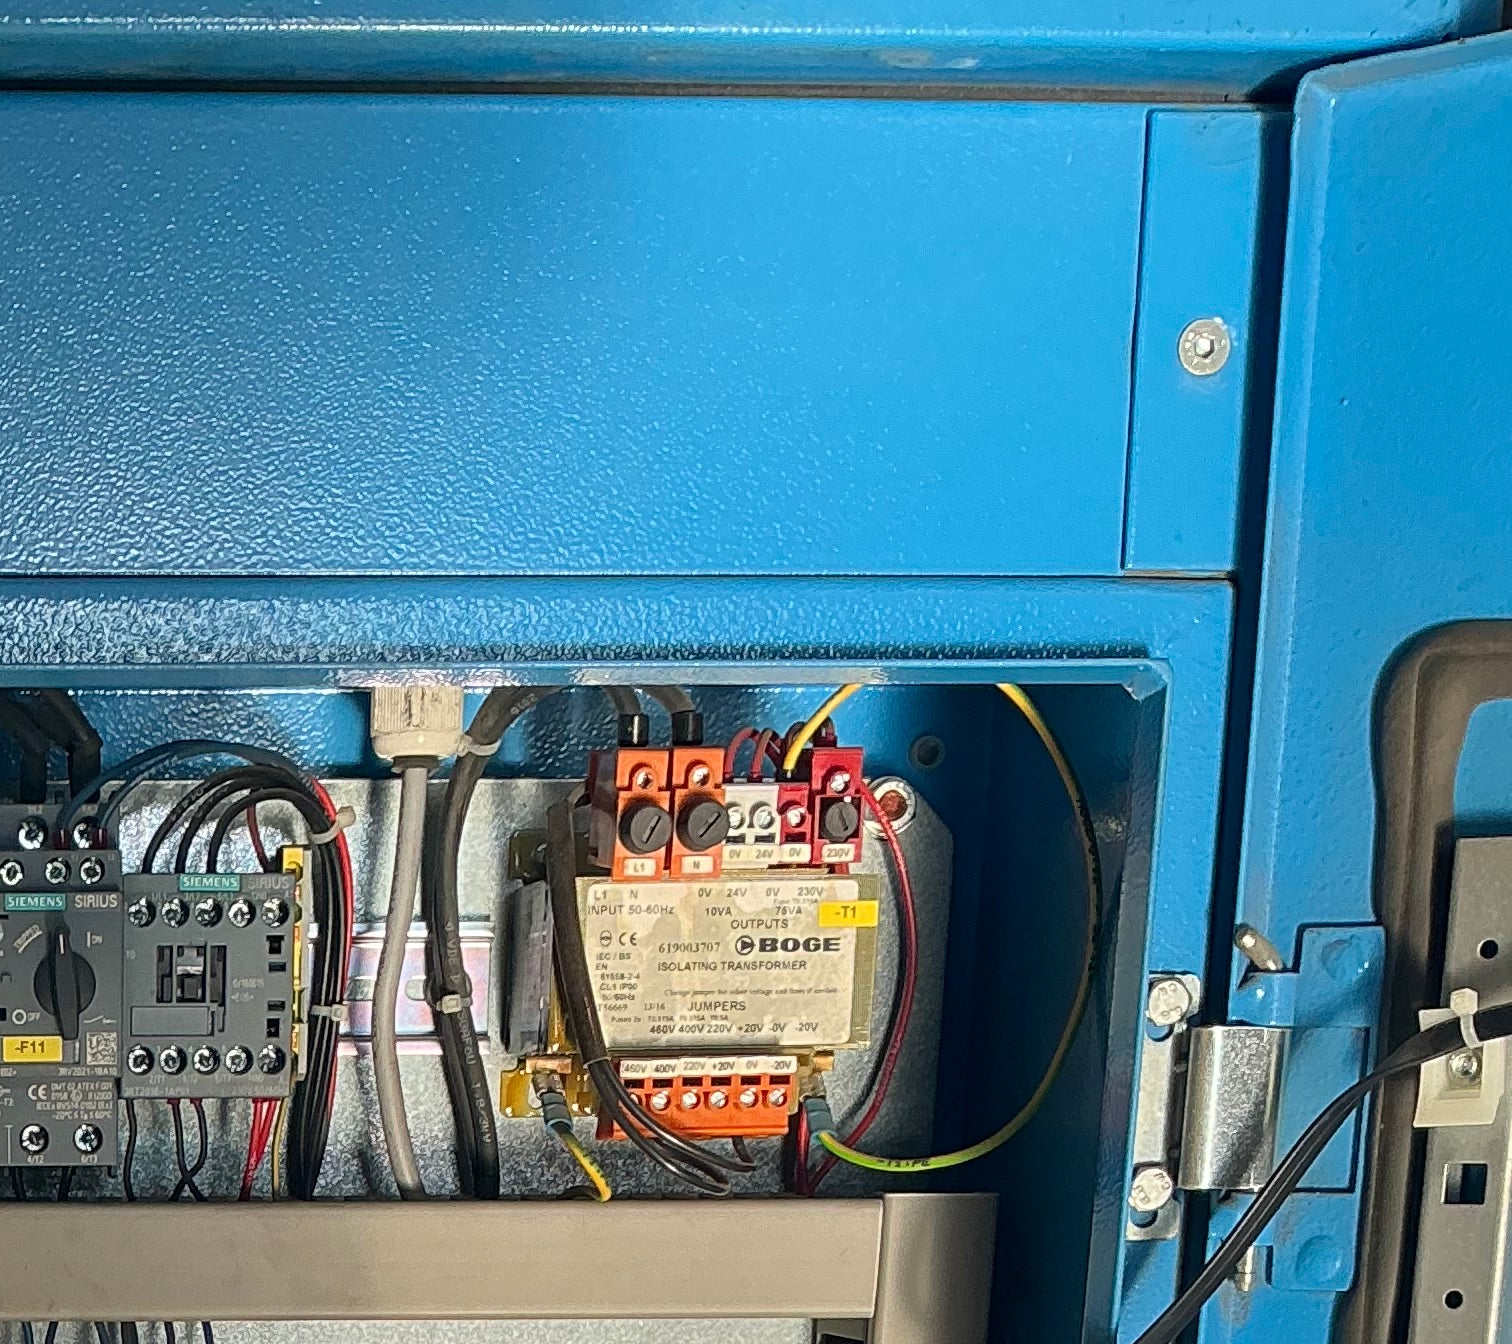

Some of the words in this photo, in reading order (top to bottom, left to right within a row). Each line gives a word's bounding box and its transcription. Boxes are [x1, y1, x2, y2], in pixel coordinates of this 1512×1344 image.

[634, 863, 644, 872] L1
[183, 877, 239, 887] SIEMENS
[248, 877, 289, 889] SIRIUS
[594, 890, 607, 900] L1
[630, 890, 638, 899] N
[698, 889, 711, 897] 0V
[727, 888, 747, 897] 24V
[766, 888, 779, 897] 0V
[798, 887, 824, 896] 230V
[7, 898, 63, 907] SIEMENS
[75, 895, 117, 908] SIRIUS
[588, 905, 624, 915] INPUT
[628, 905, 675, 915] 50-60Hz
[705, 907, 732, 916] 10VA
[834, 906, 857, 918] -T1
[731, 919, 788, 929] OUTPUTS
[759, 937, 841, 952] BOGE
[658, 962, 718, 971] ISOLATING
[721, 961, 806, 970] TRANSFORMER
[688, 1001, 746, 1011] JUMPERS
[678, 1024, 704, 1034] 400V
[707, 1024, 733, 1032] 220V
[14, 1041, 46, 1054] -F11
